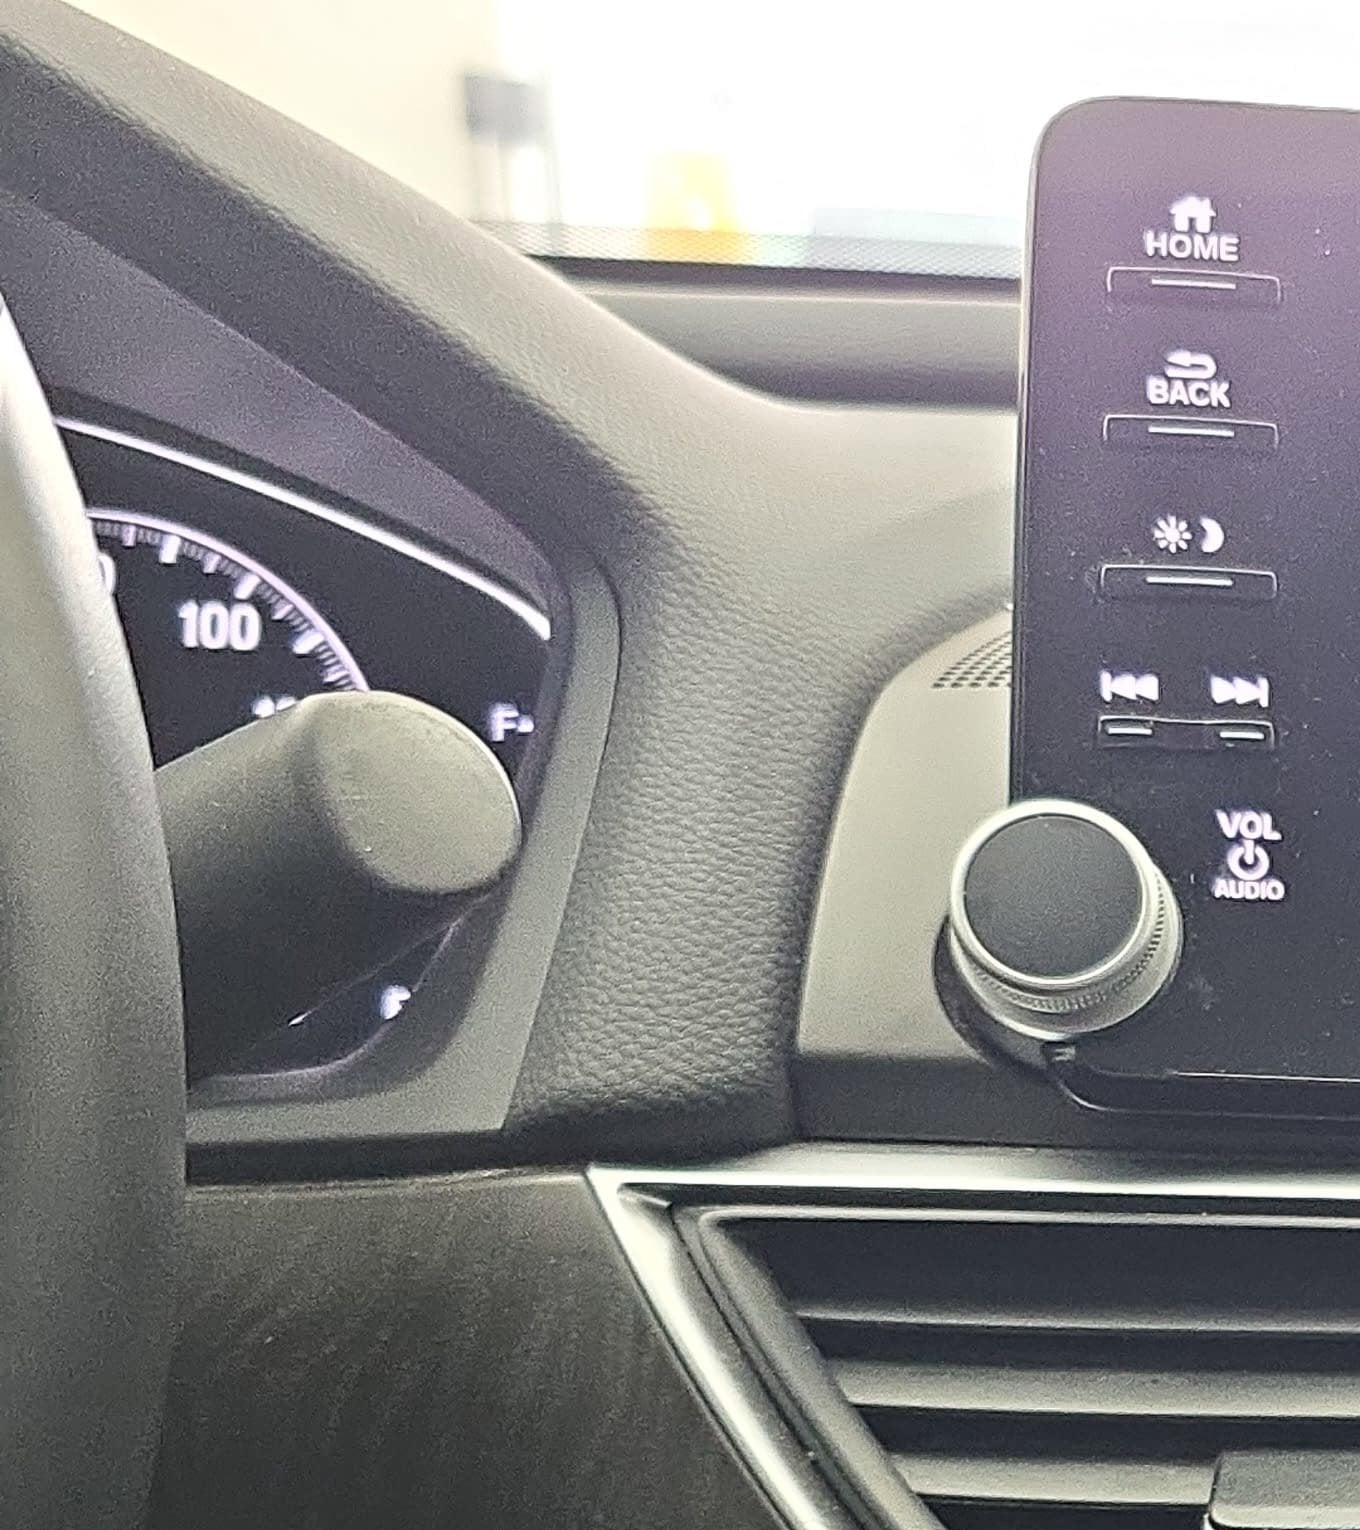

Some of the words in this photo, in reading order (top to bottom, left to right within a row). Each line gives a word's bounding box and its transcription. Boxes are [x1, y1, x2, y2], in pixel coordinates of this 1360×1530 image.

[1143, 230, 1240, 262] HOME
[1146, 375, 1232, 408] BACK
[177, 600, 262, 651] 100
[1215, 808, 1283, 842] VOL
[1212, 878, 1286, 901] AUDIO
